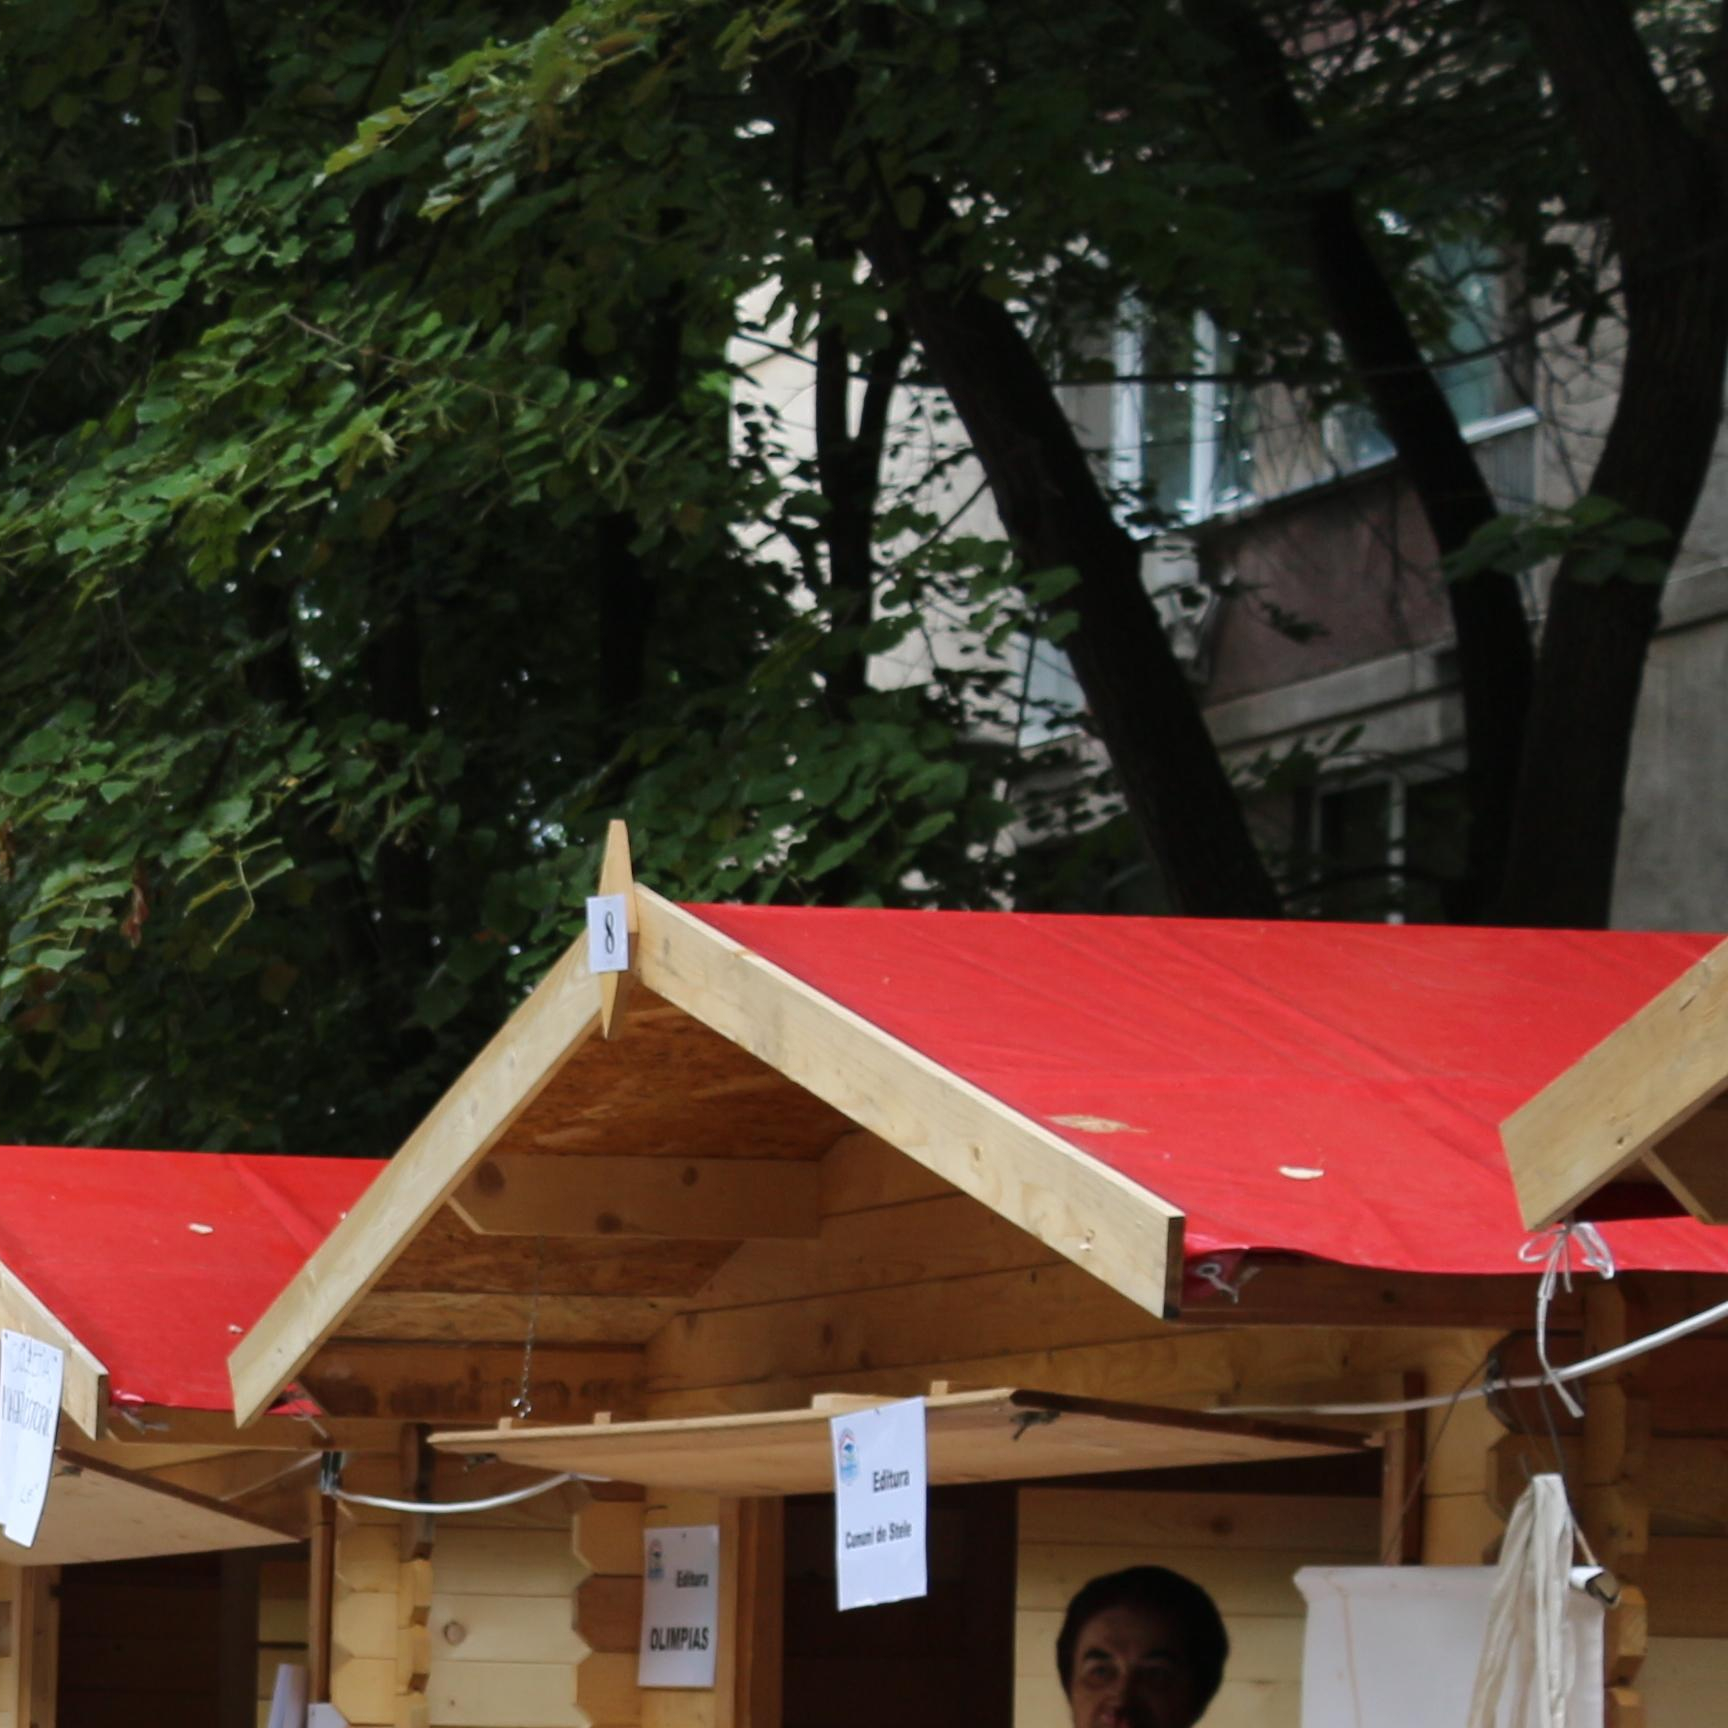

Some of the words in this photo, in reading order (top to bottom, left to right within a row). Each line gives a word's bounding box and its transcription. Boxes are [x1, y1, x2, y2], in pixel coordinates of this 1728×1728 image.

[604, 910, 615, 955] 8
[873, 1468, 910, 1493] Editura
[876, 1524, 887, 1542] de
[889, 1519, 912, 1541] Stele
[676, 1569, 709, 1588] Editura
[650, 1626, 709, 1651] OLIMPIAS
